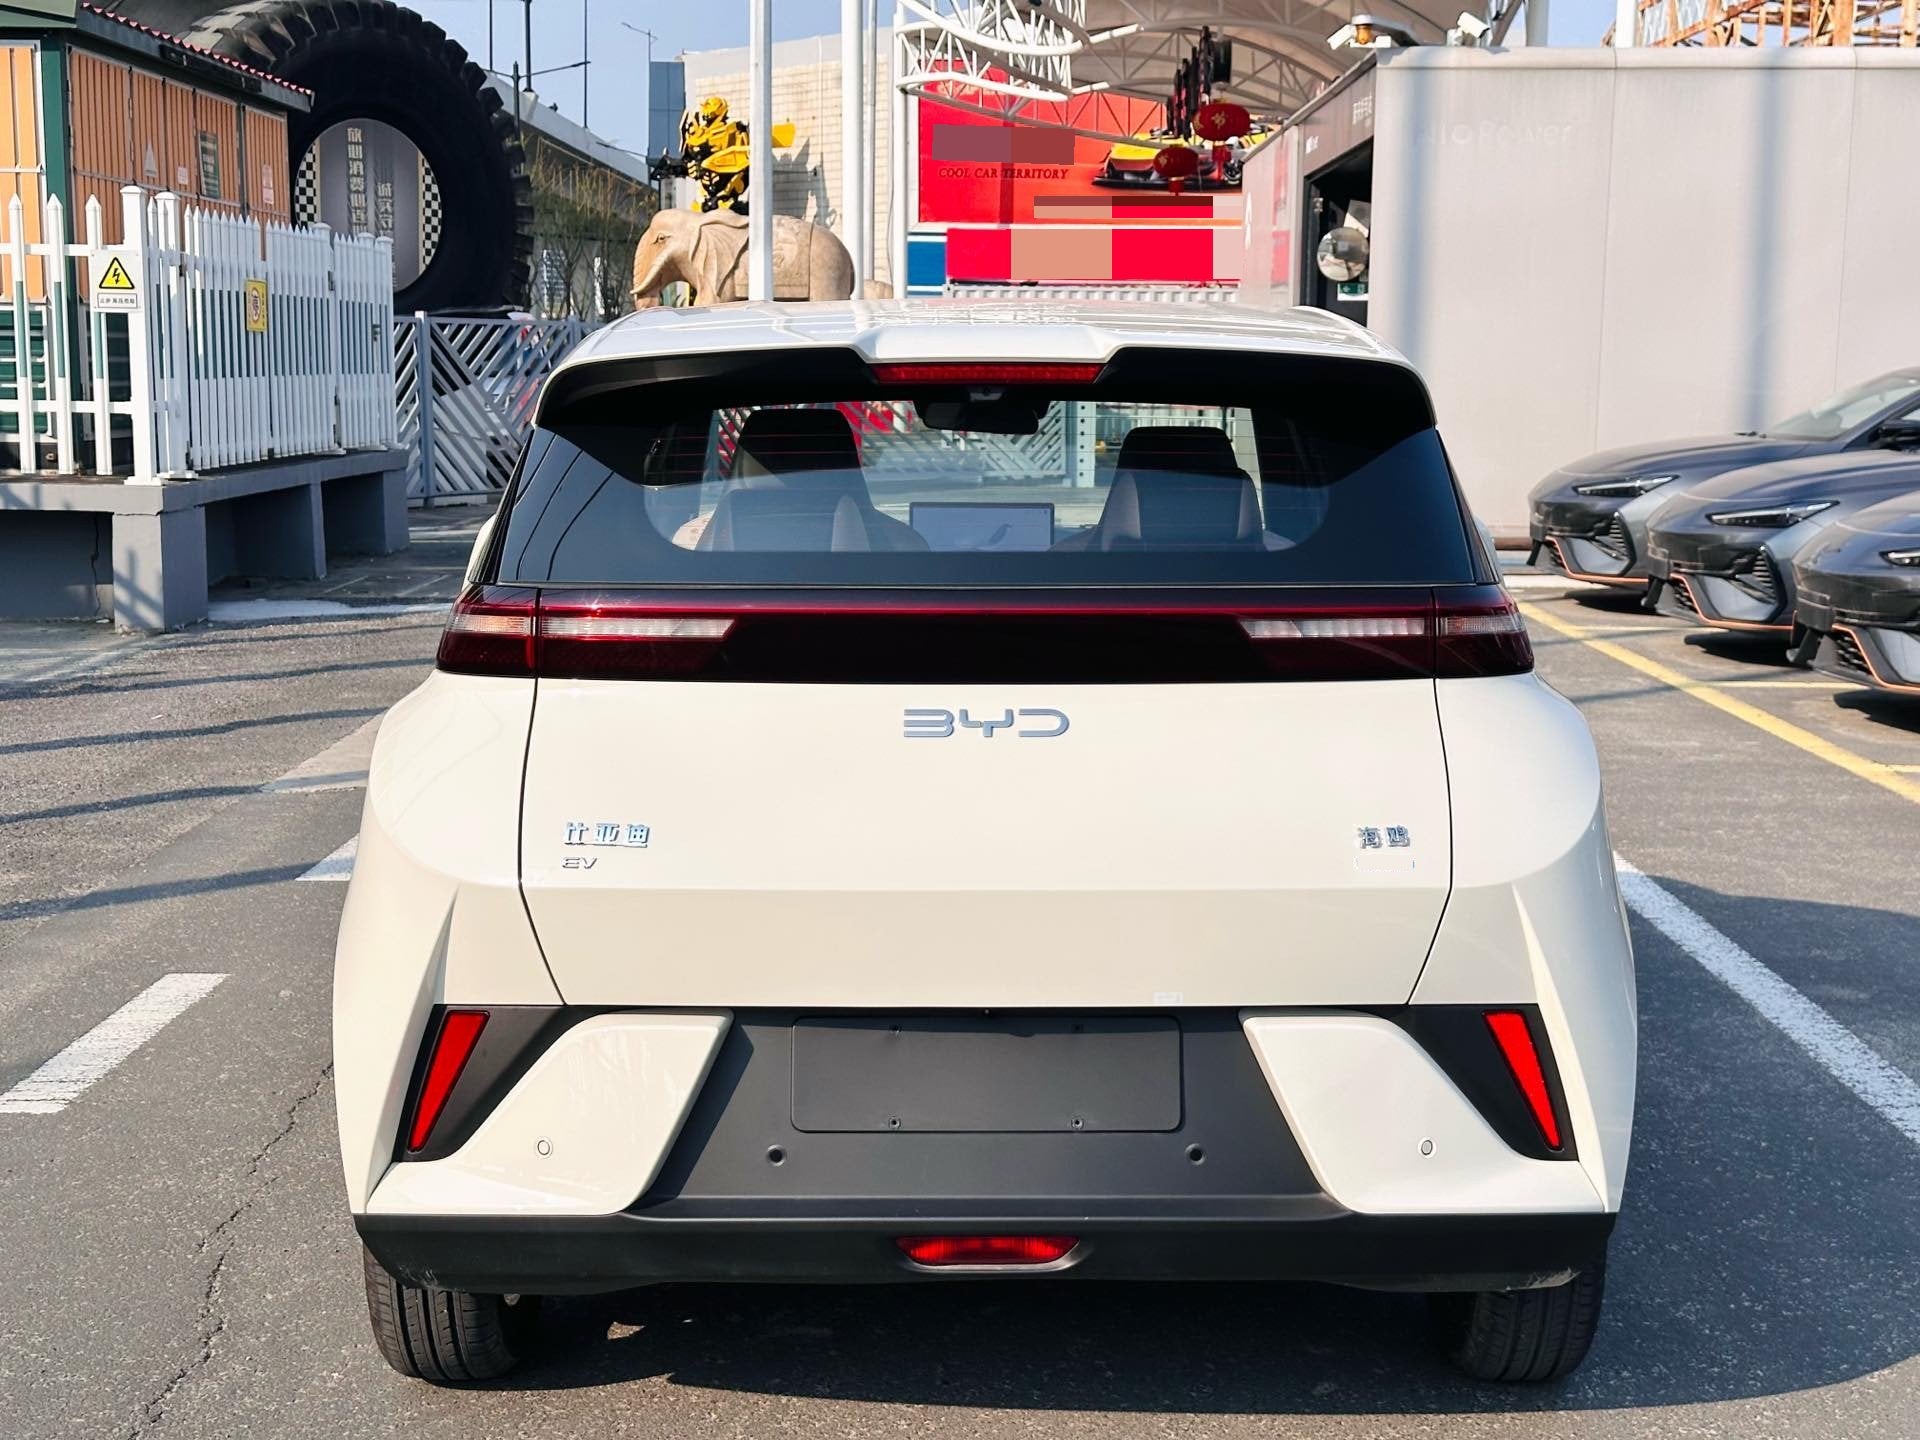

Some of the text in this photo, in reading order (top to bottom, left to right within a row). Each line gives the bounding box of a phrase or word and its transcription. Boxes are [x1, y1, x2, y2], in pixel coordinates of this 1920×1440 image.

[938, 167, 1069, 180] COOL CAR TERRITORY
[904, 709, 1069, 738] BYD
[564, 822, 650, 848] 比亚迪
[562, 856, 598, 870] EV
